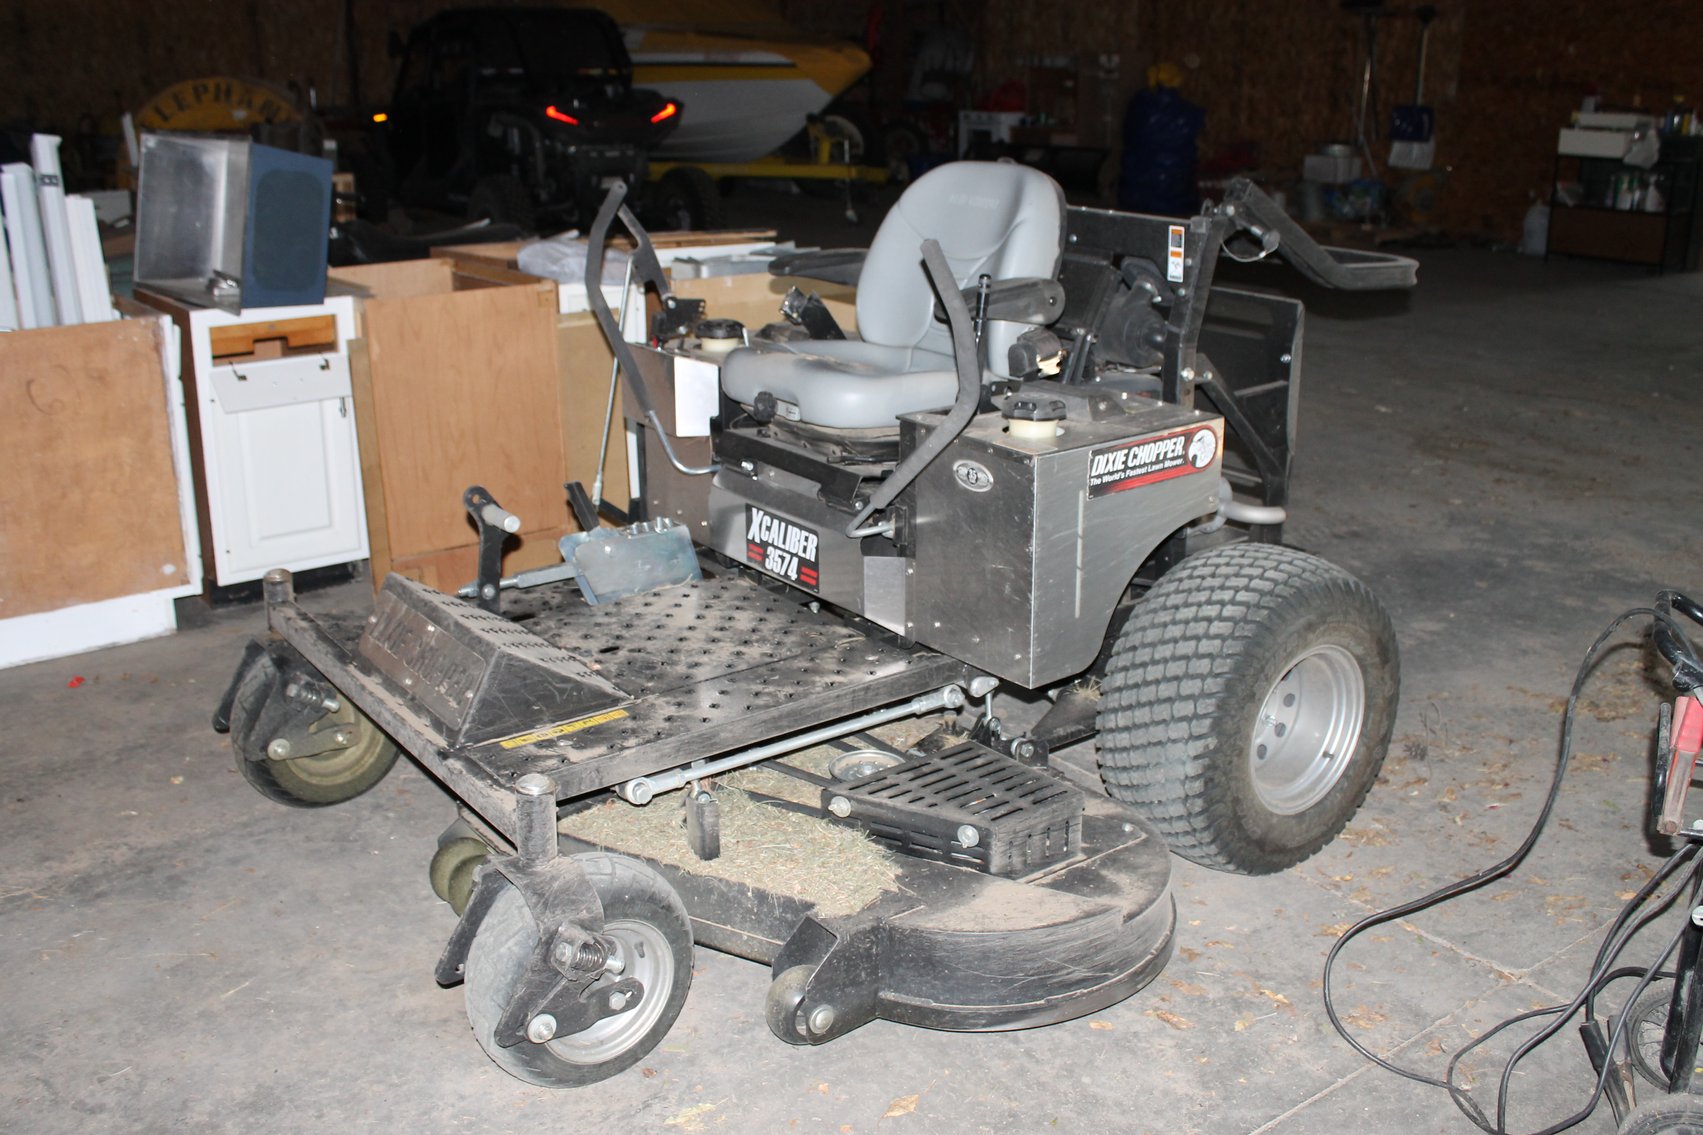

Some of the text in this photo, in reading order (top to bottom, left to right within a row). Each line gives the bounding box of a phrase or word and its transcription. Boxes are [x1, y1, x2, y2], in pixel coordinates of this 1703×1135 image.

[1090, 476, 1102, 486] The
[1102, 470, 1125, 483] World's
[1125, 465, 1148, 478] Fastest
[1148, 462, 1164, 473] Lawn
[1091, 449, 1129, 477] DIXIE
[747, 507, 818, 562] XCALIBER
[765, 546, 799, 581] 3574
